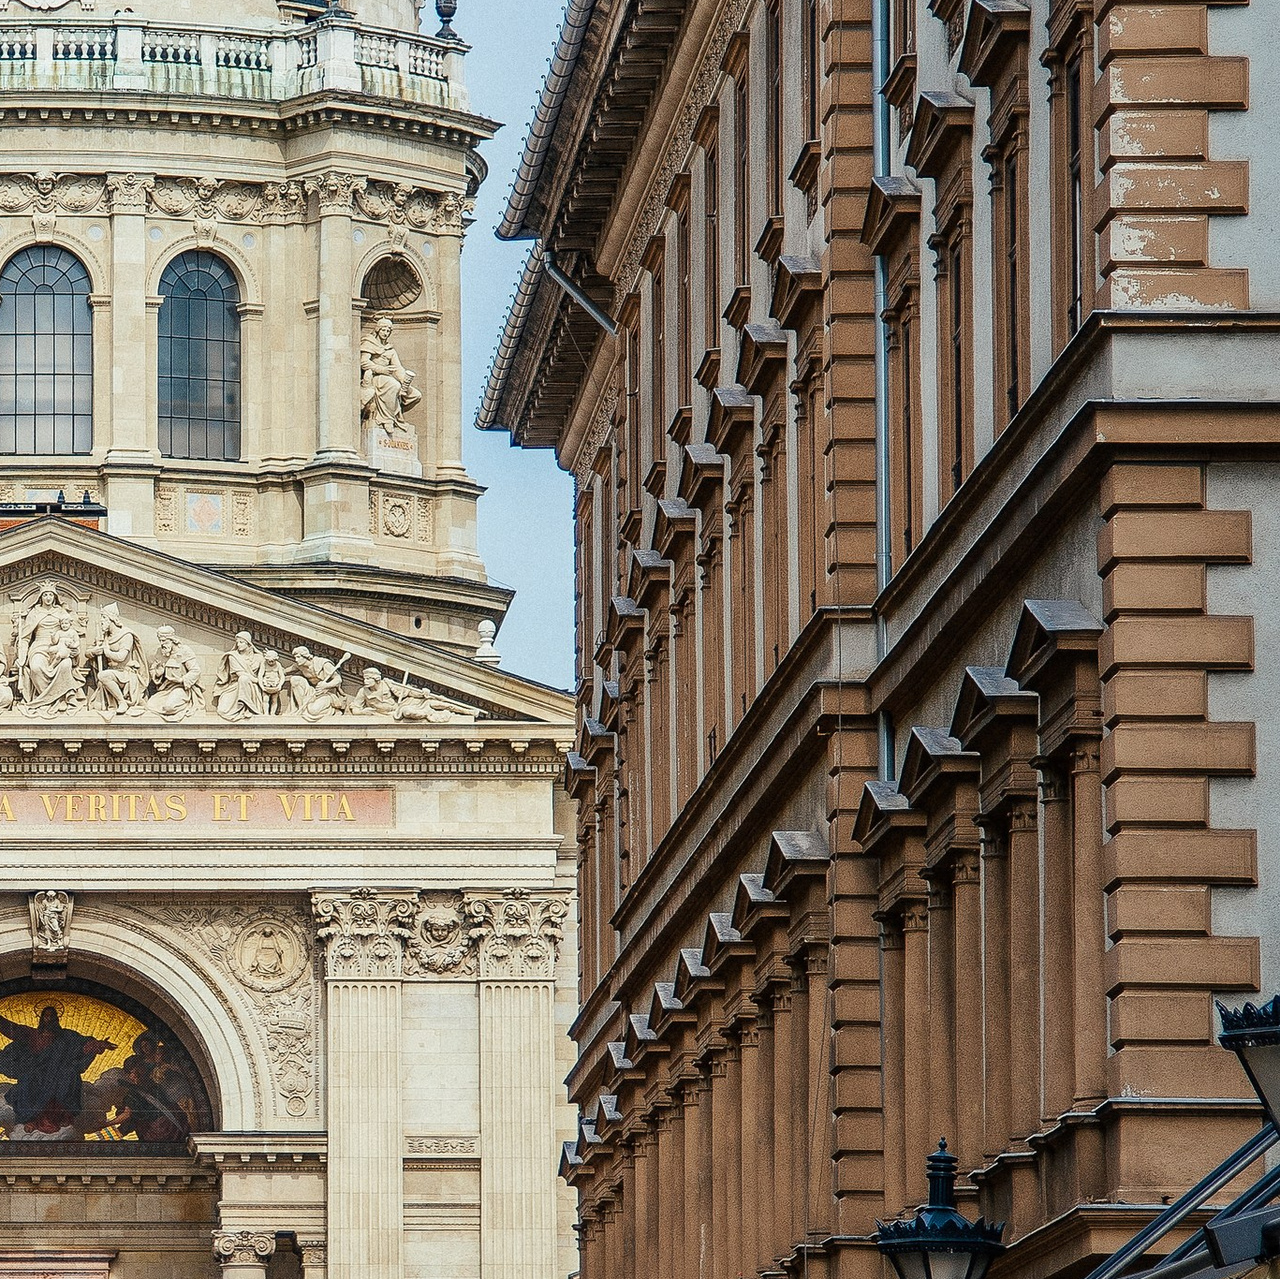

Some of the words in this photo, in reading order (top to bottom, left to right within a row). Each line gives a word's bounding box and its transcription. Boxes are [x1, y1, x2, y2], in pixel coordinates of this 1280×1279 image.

[39, 793, 188, 821] VERITAS
[212, 793, 257, 821] ET
[277, 793, 357, 821] VITA
